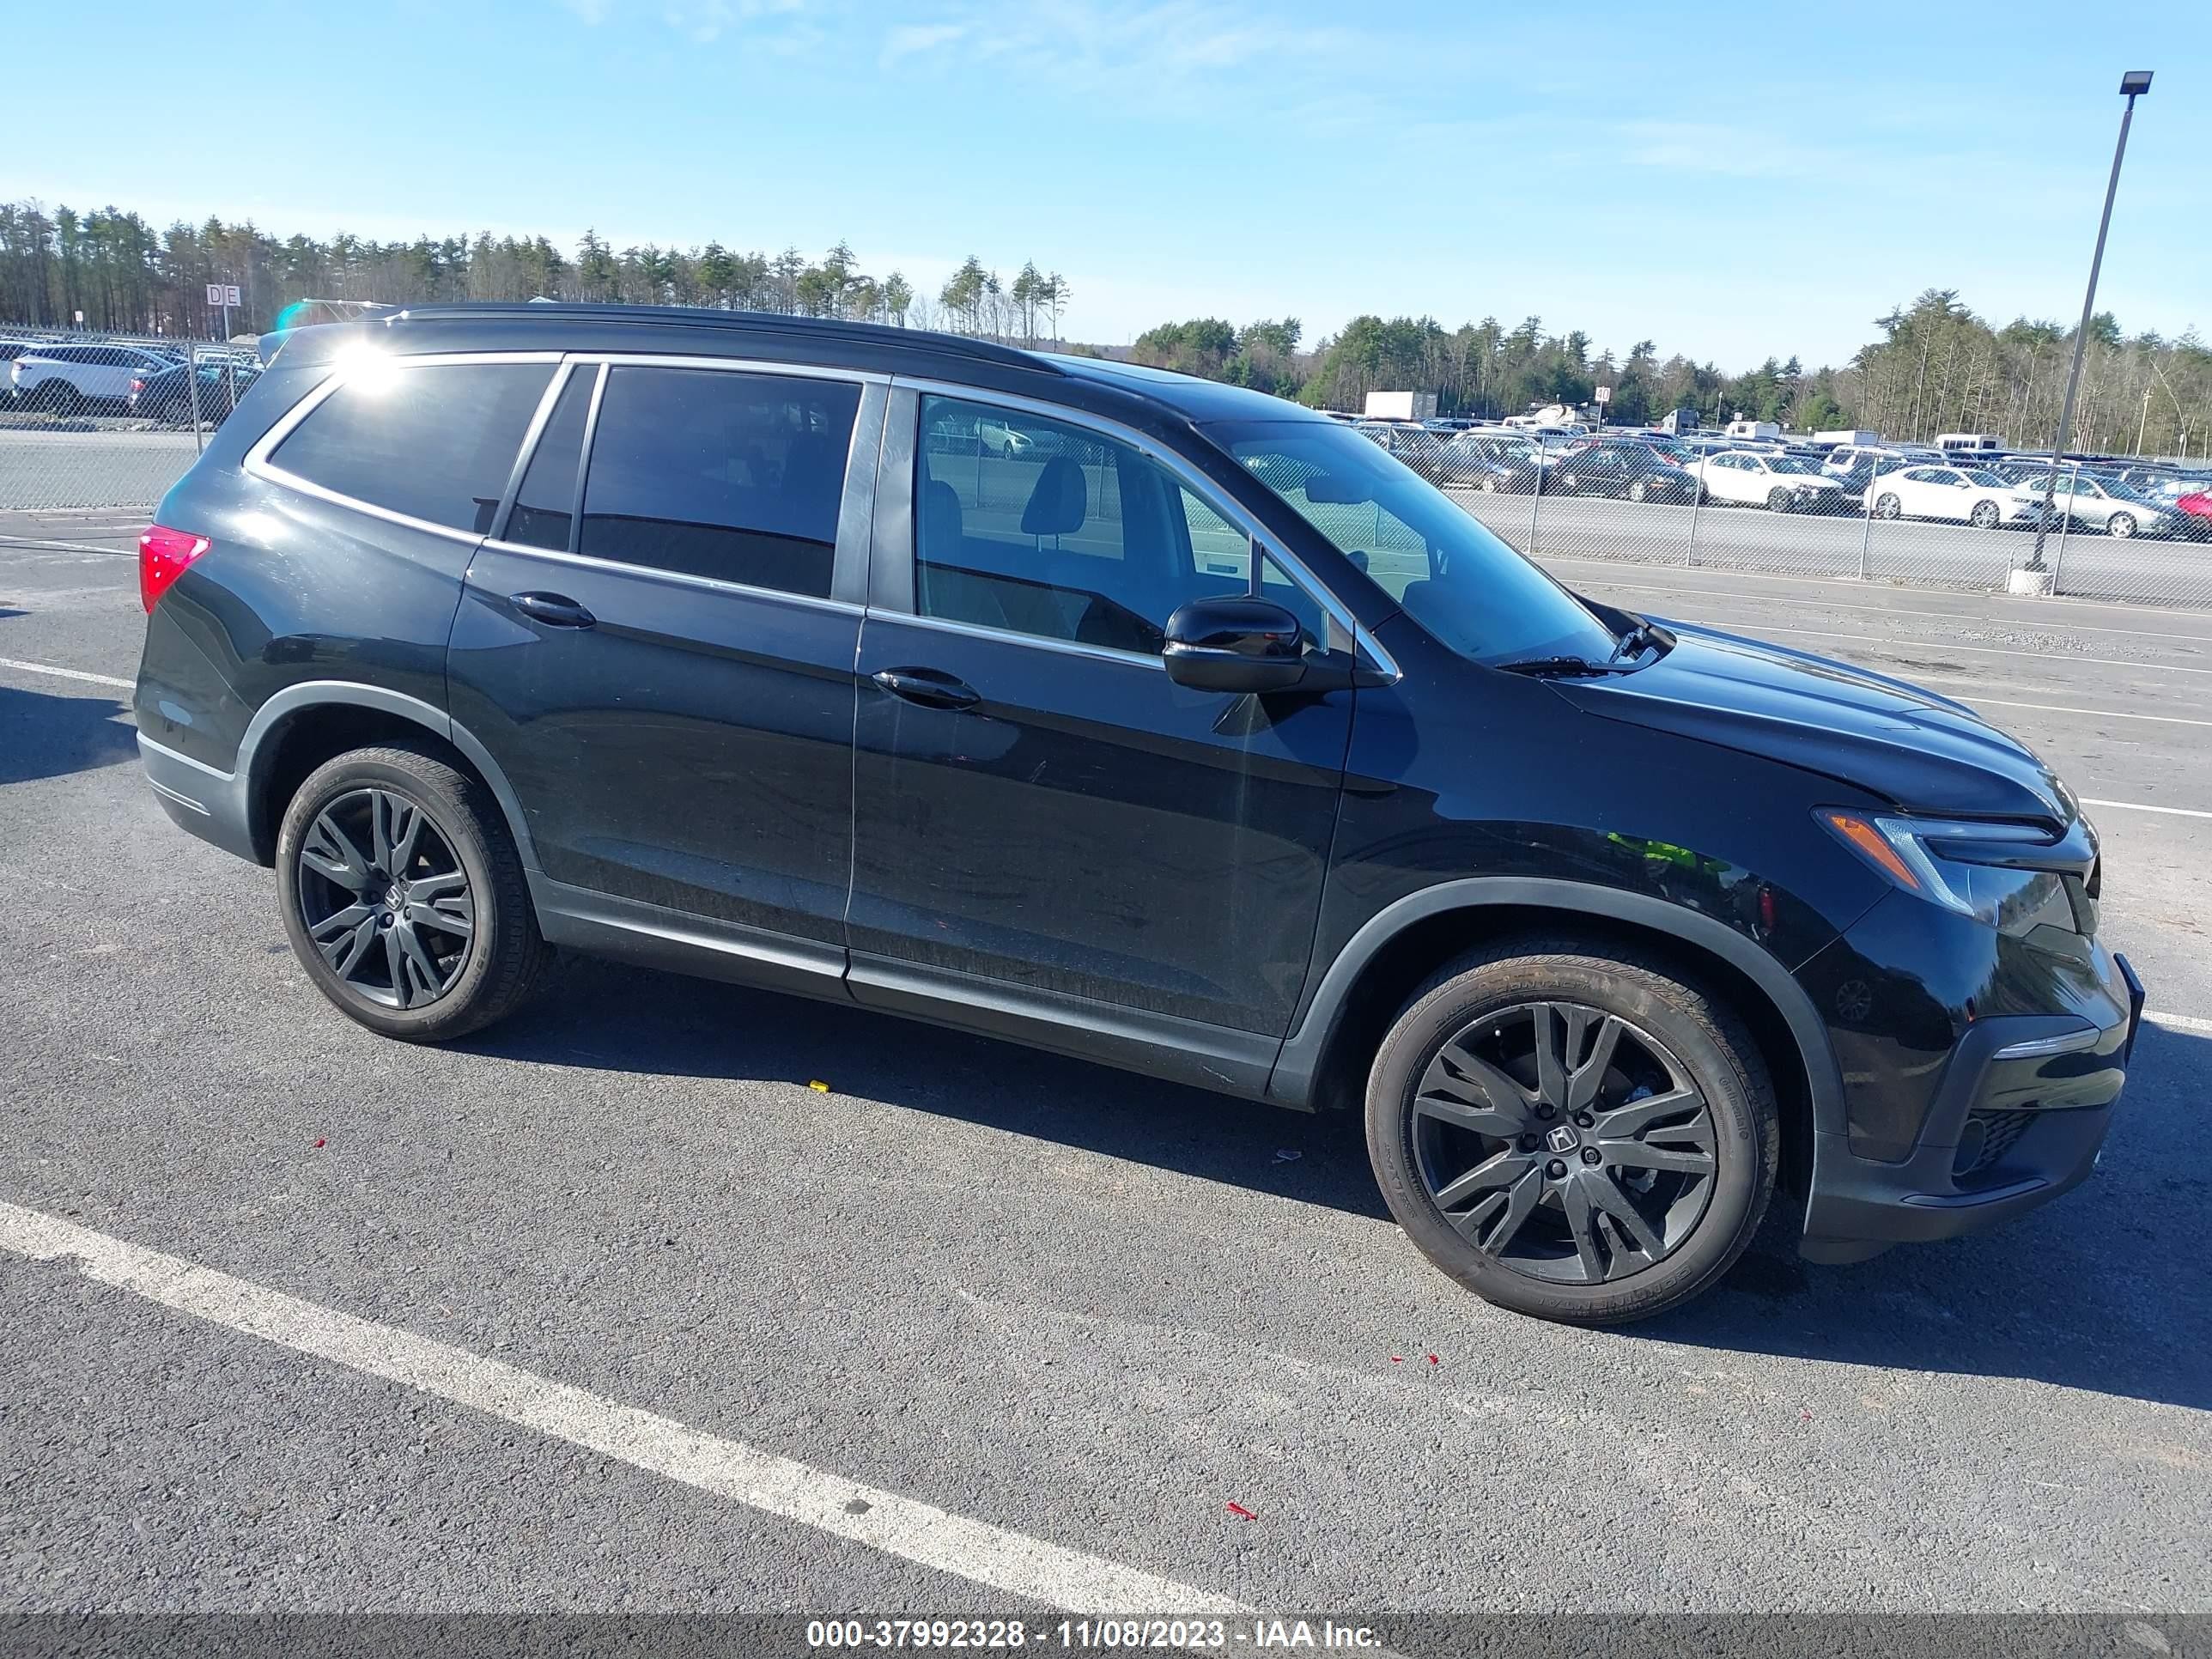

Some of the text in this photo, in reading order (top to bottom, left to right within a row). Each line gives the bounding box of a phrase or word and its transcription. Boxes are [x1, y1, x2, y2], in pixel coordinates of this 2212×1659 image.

[210, 287, 237, 304] D E
[1597, 389, 1608, 399] 40
